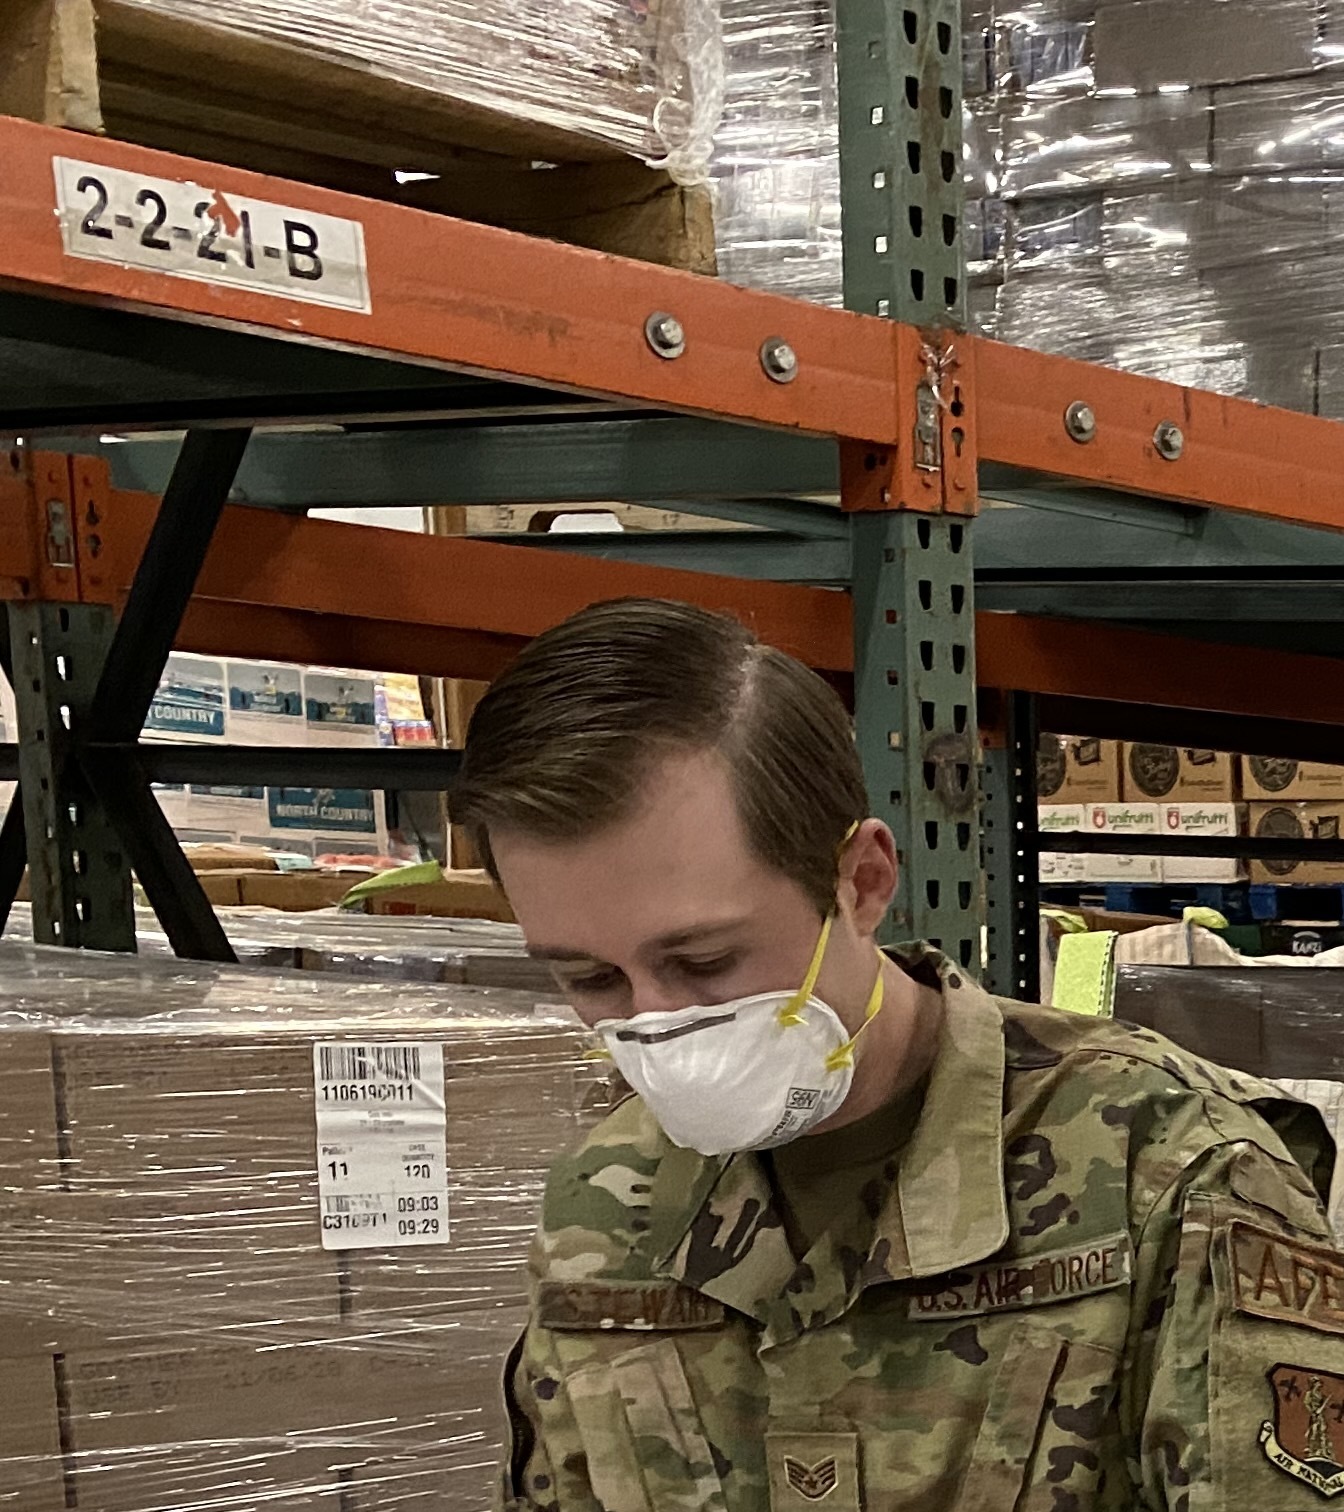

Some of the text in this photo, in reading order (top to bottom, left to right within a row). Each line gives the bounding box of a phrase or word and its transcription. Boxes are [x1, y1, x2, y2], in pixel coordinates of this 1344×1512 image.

[77, 175, 323, 280] 2-2-21-B
[154, 706, 216, 726] COUNTRY
[1040, 811, 1081, 827] nifrutti
[397, 1195, 440, 1213] 09:03
[398, 1218, 440, 1236] 09:29
[975, 1267, 1021, 1309] AIR
